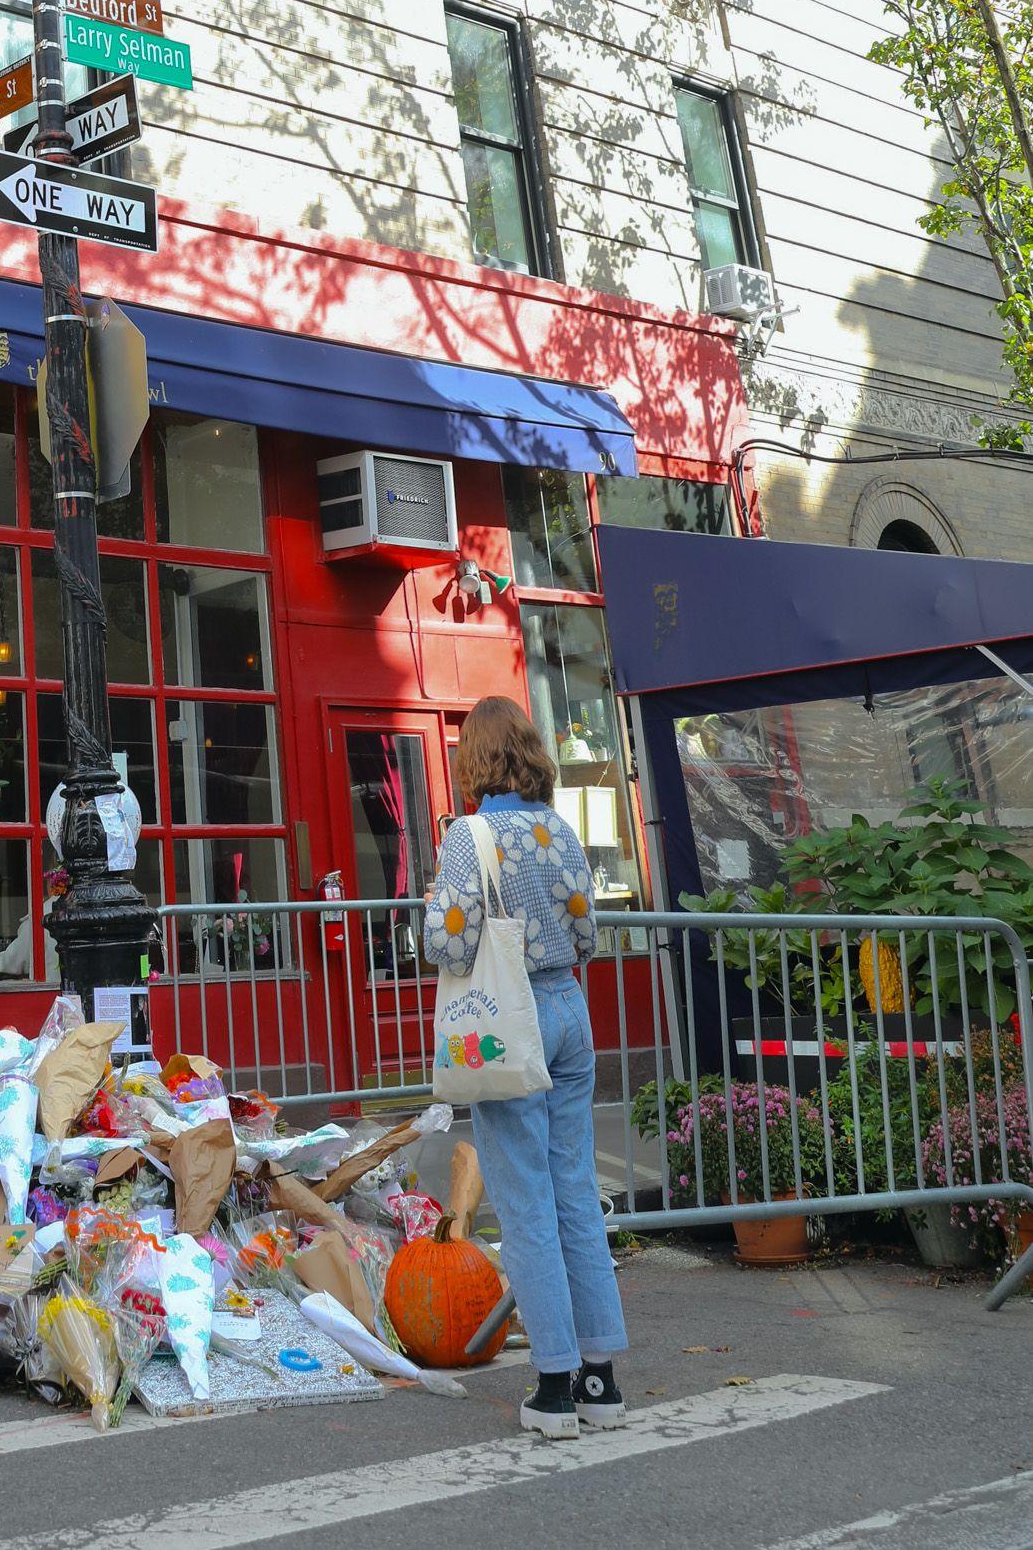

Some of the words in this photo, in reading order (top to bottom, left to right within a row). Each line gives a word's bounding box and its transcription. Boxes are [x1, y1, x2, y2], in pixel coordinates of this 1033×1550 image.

[145, 3, 157, 22] St
[68, 20, 113, 58] Larry
[119, 33, 185, 69] Selman
[118, 57, 140, 75] Way
[7, 78, 17, 98] St
[78, 102, 118, 142] WAY
[15, 178, 63, 211] ONE
[86, 193, 135, 226] WAY
[148, 381, 169, 403] wl
[599, 451, 616, 471] 90
[396, 494, 429, 504] FRIEDRICH
